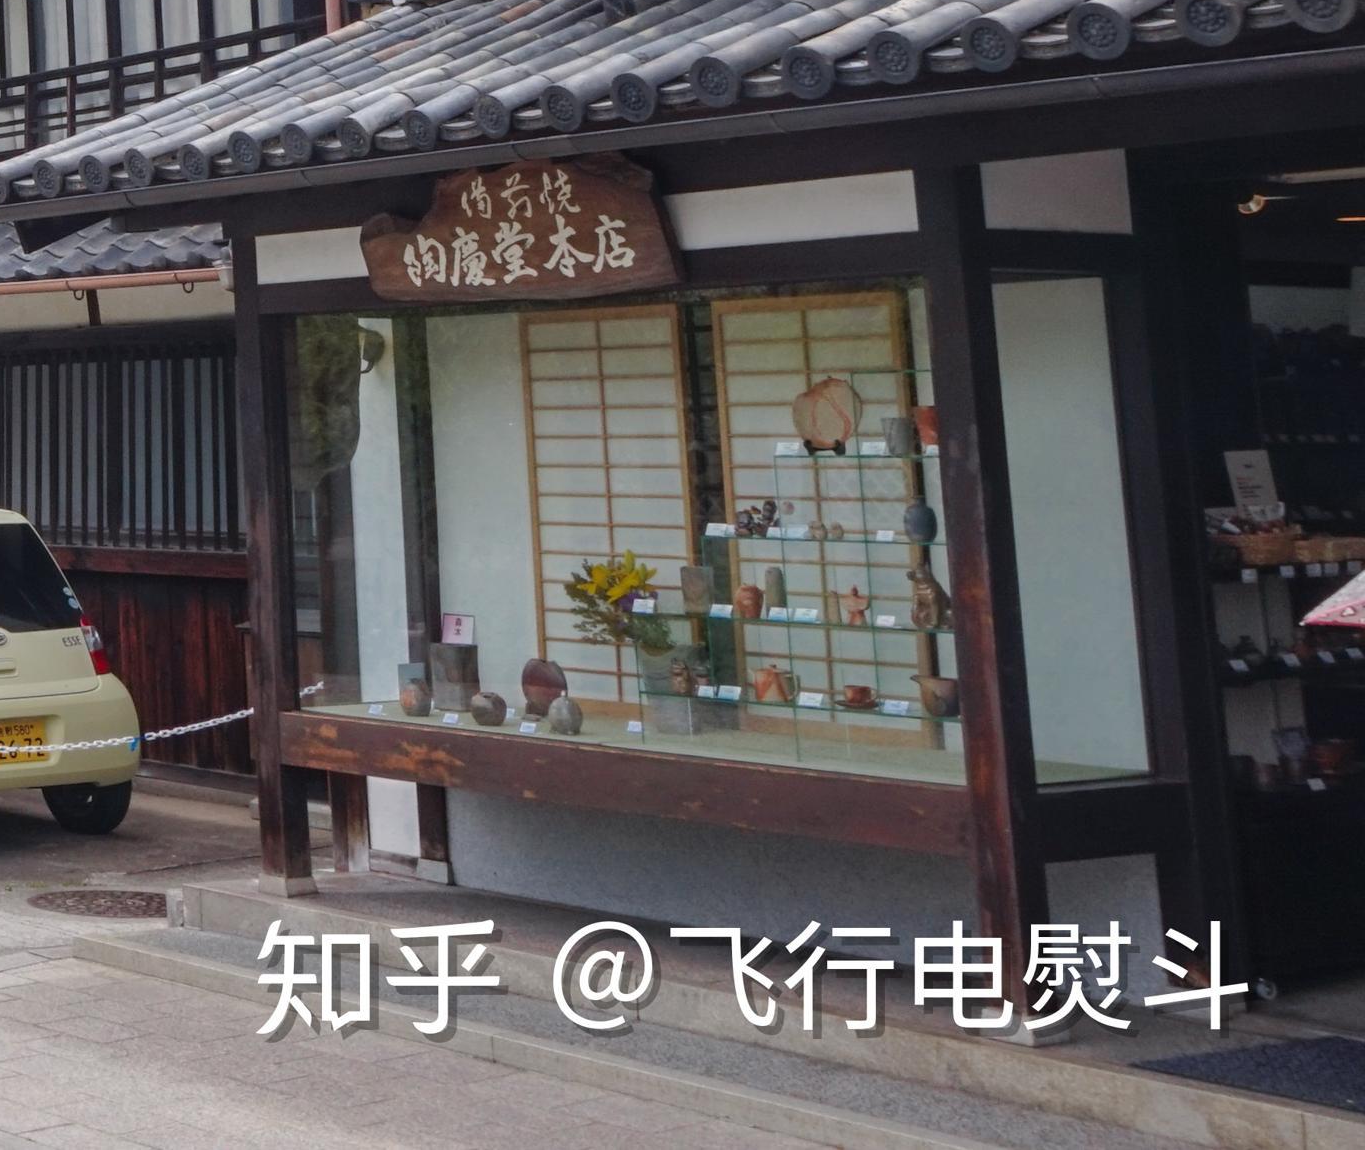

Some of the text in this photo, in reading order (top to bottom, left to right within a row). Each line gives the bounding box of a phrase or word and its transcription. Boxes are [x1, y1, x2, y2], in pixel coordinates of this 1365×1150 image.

[403, 214, 636, 287] 陶慶堂本店
